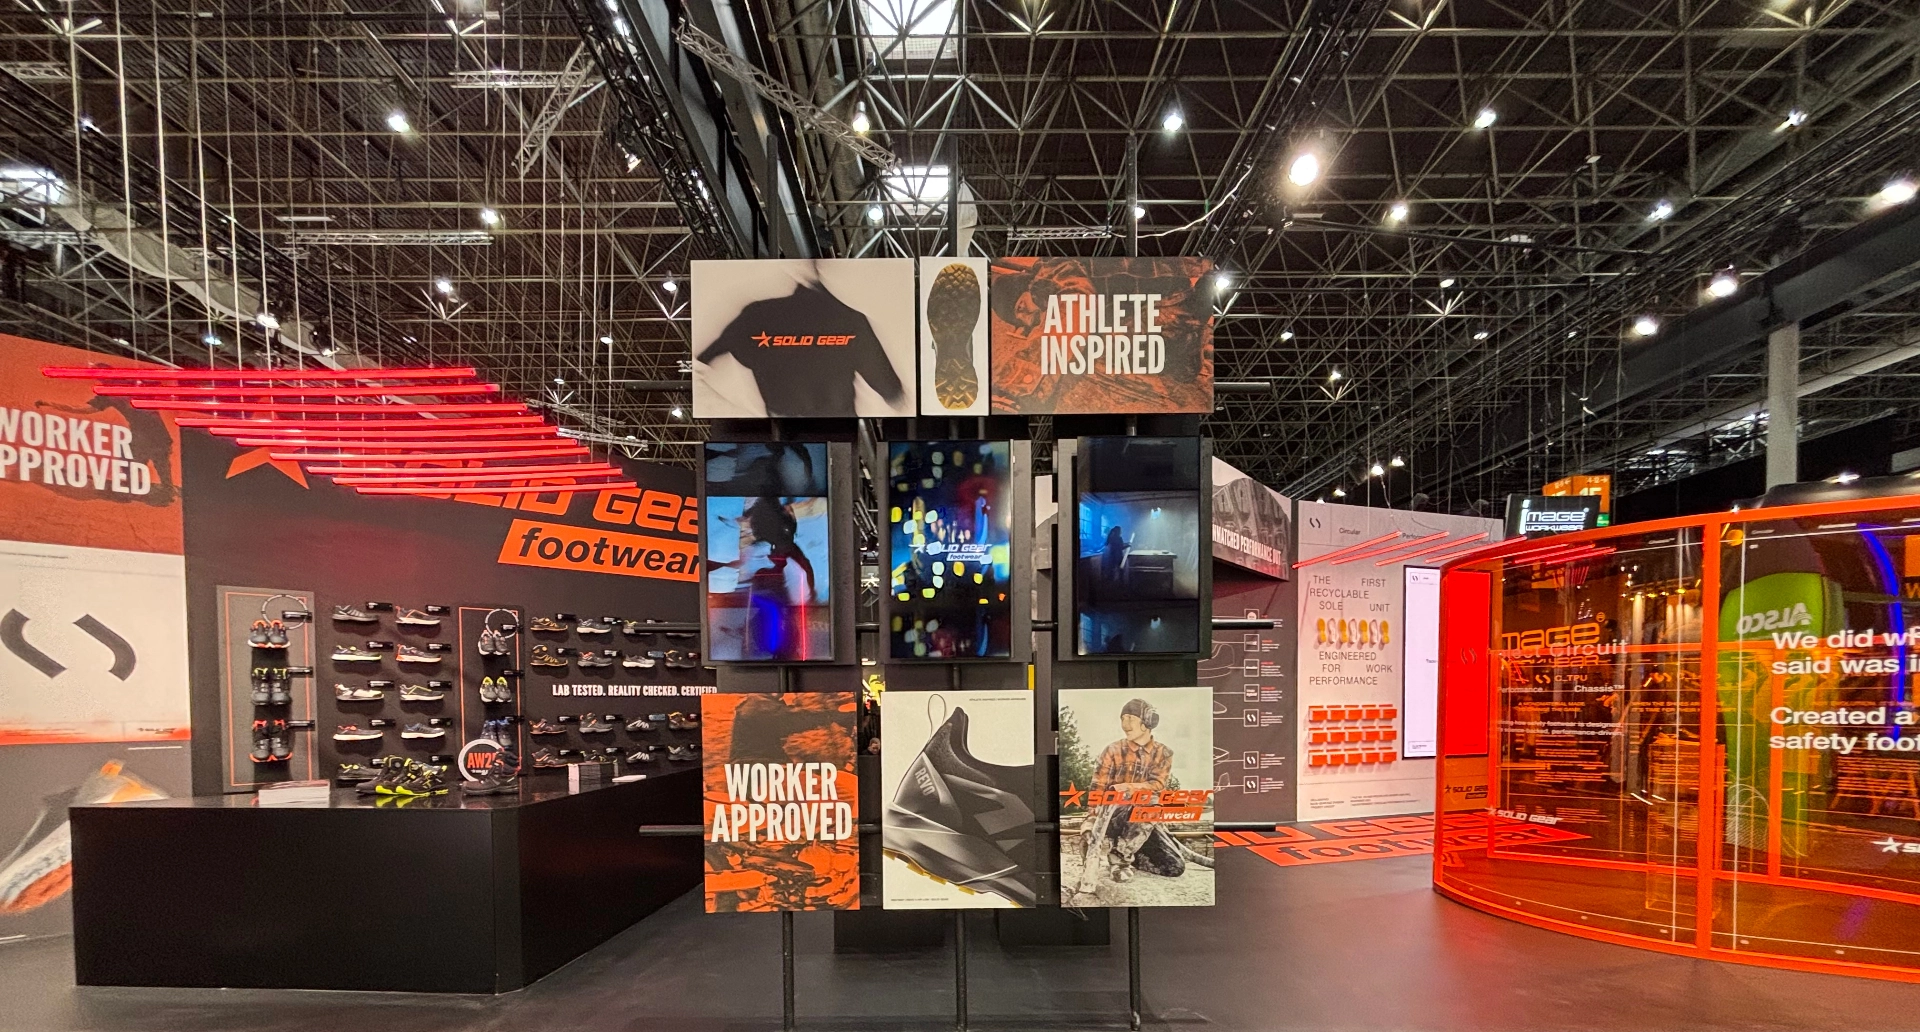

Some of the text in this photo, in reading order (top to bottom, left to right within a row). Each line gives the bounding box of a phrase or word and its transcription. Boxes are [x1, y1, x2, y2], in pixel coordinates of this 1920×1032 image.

[1043, 293, 1163, 333] ATHLETE
[773, 335, 812, 347] SOLID
[1040, 334, 1166, 375] INSPIRED
[0, 407, 133, 459] WORKER
[1339, 527, 1361, 536] Circular
[1313, 576, 1386, 588] THE FIRST
[1309, 588, 1370, 599] RECYCLABLE
[1319, 601, 1391, 613] SOLE UNIT
[1771, 631, 1818, 649] We
[1826, 629, 1874, 648] did
[1318, 651, 1377, 661] ENGINEERED
[1549, 639, 1628, 657] Circuit
[1322, 663, 1393, 673] FOR WORK
[1771, 654, 1920, 674] said was i
[1309, 676, 1378, 686] PERFORMANCE
[552, 684, 570, 696] LAB
[572, 685, 606, 696] TESTED.
[608, 685, 642, 696] REALITY
[643, 686, 680, 696] CHECKED.
[1770, 706, 1913, 725] Created a
[1769, 732, 1858, 754] safety
[724, 761, 837, 803] WORKER
[915, 767, 936, 796] REVO
[1087, 790, 1151, 805] SOLID
[712, 801, 853, 843] APPROVED
[1497, 809, 1528, 821] SOLID
